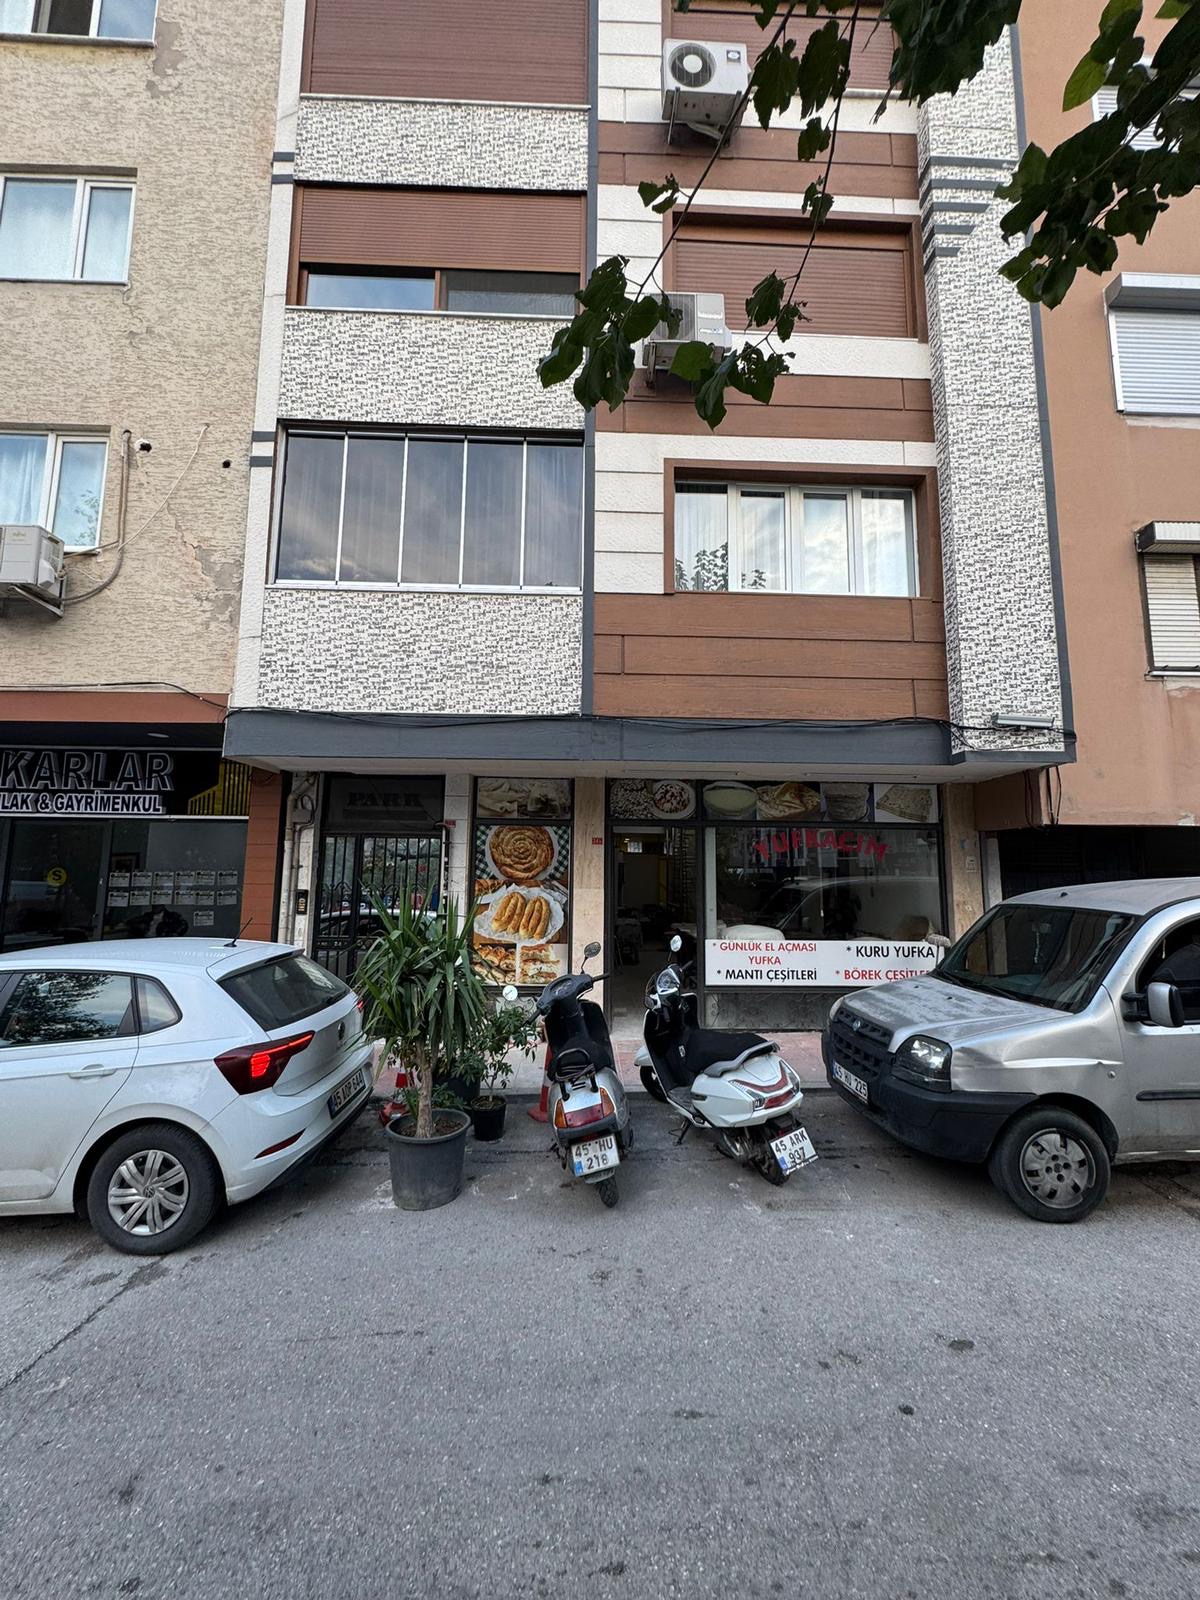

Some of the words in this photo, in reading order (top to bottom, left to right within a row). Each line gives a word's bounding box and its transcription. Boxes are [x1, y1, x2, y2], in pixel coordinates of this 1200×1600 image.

[0, 751, 173, 791] KARLAR
[38, 792, 50, 812] &
[54, 790, 164, 814] GAYRİMENKUL
[719, 941, 762, 952] GÜNLÜK
[765, 942, 776, 952] EL
[778, 942, 817, 954] AÇMASI
[855, 946, 890, 958] KURU
[893, 946, 935, 958] YUFKA
[747, 955, 782, 965] YUFKA
[725, 969, 763, 980] MANTI
[766, 967, 817, 983] ÇEŞİTLERİ
[844, 968, 880, 980] BÖREK
[575, 1143, 590, 1157] 45
[599, 1137, 613, 1152] HU
[775, 1140, 787, 1154] 45
[789, 1130, 807, 1147] ARK
[586, 1153, 609, 1170] 218
[788, 1146, 806, 1162] 937
